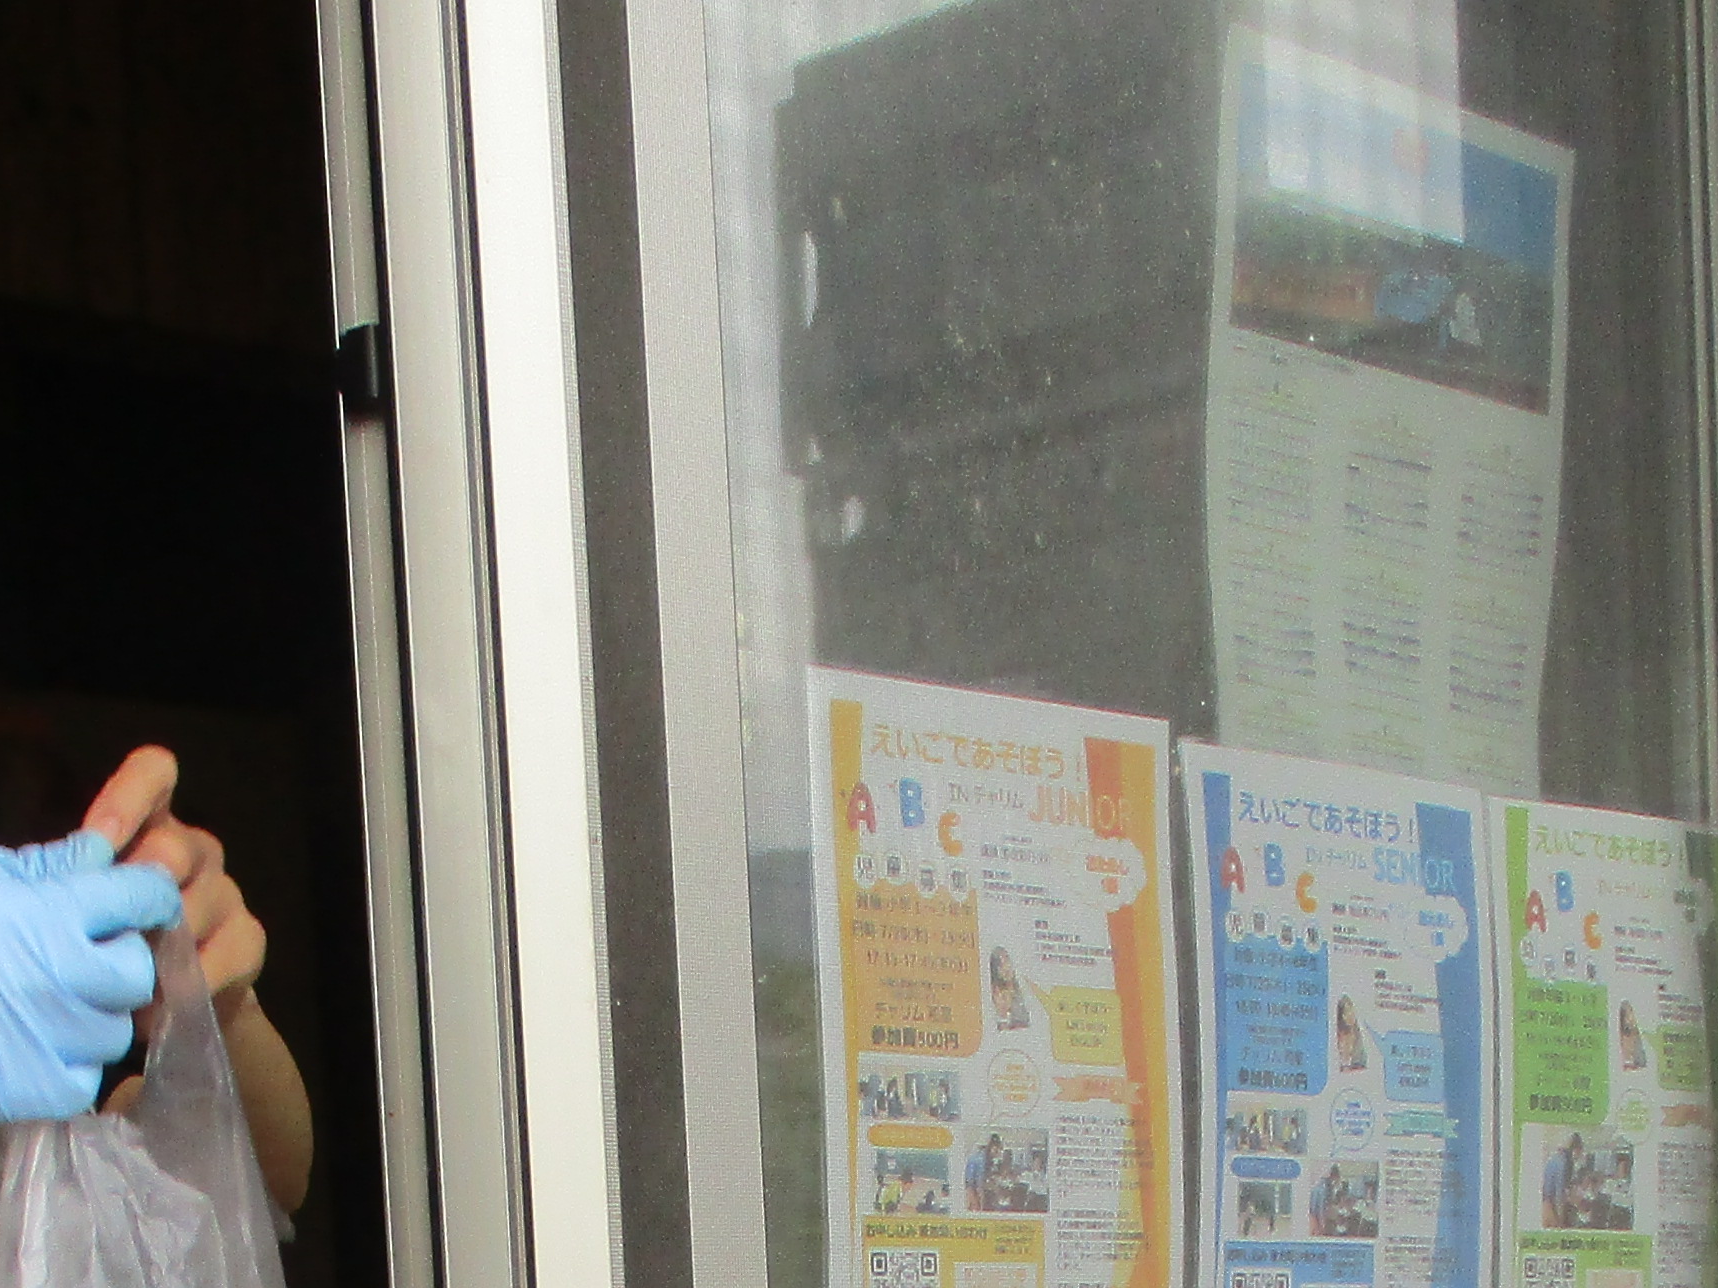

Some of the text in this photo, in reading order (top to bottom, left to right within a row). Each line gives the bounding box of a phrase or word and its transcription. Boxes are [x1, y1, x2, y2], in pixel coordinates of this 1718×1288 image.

[847, 781, 877, 834] A
[899, 777, 927, 828] B
[938, 813, 964, 856] C
[1220, 847, 1246, 894] A
[1263, 842, 1286, 887] B
[1295, 871, 1319, 914] C
[1525, 890, 1548, 933] A
[1555, 870, 1575, 913] B
